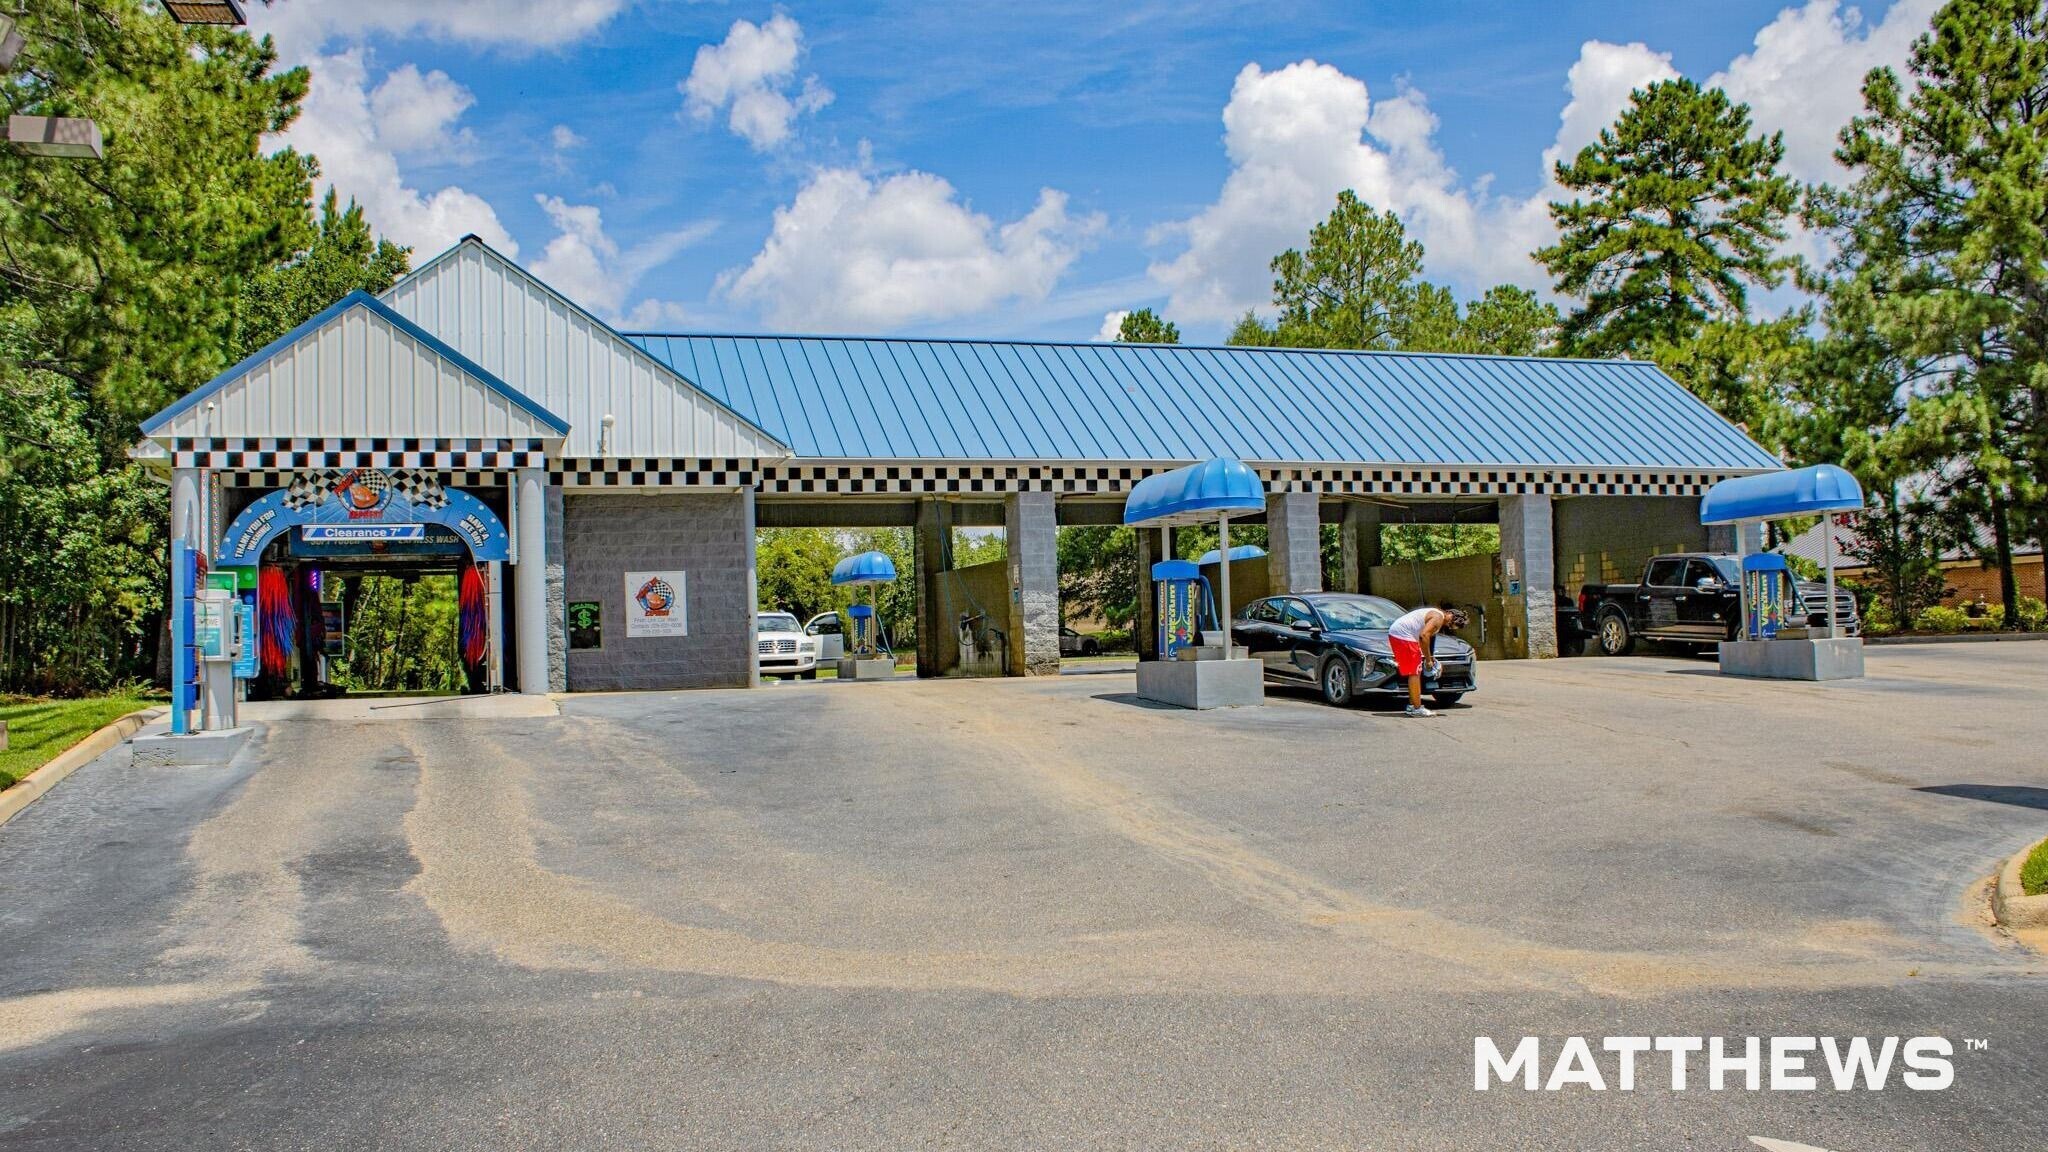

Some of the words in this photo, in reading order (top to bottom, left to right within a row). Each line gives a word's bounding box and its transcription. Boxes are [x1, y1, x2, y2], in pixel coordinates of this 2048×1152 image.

[459, 519, 475, 533] NICE
[466, 514, 487, 533] HAVE
[234, 533, 251, 558] THANK
[246, 518, 262, 535] YOU
[260, 509, 276, 523] FOR
[325, 528, 387, 537] Clearance
[390, 528, 401, 537] 7'
[436, 535, 460, 544] WASH
